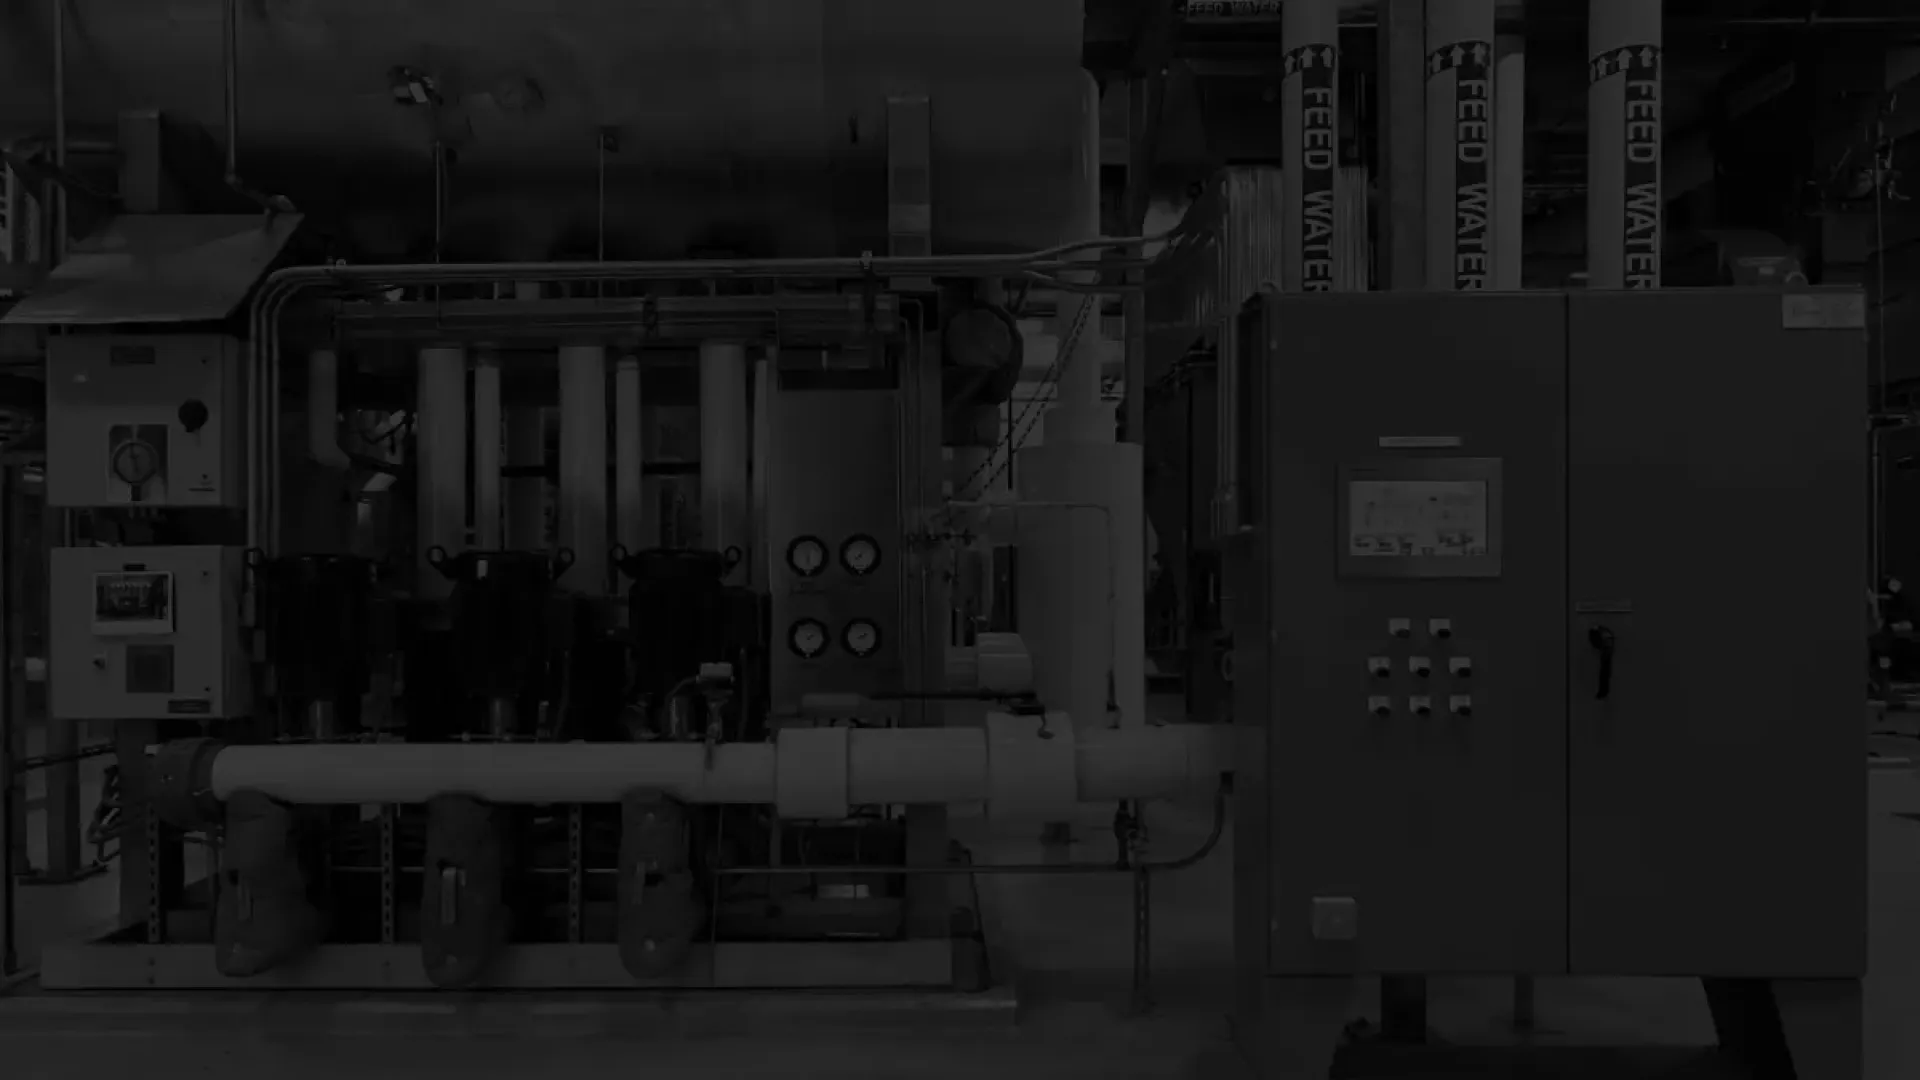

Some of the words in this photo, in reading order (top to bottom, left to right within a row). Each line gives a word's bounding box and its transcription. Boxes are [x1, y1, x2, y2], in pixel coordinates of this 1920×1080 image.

[1304, 86, 1333, 170] FEED
[1458, 79, 1488, 162] FEED
[1626, 79, 1656, 163] FEED
[1458, 182, 1488, 291] WATER
